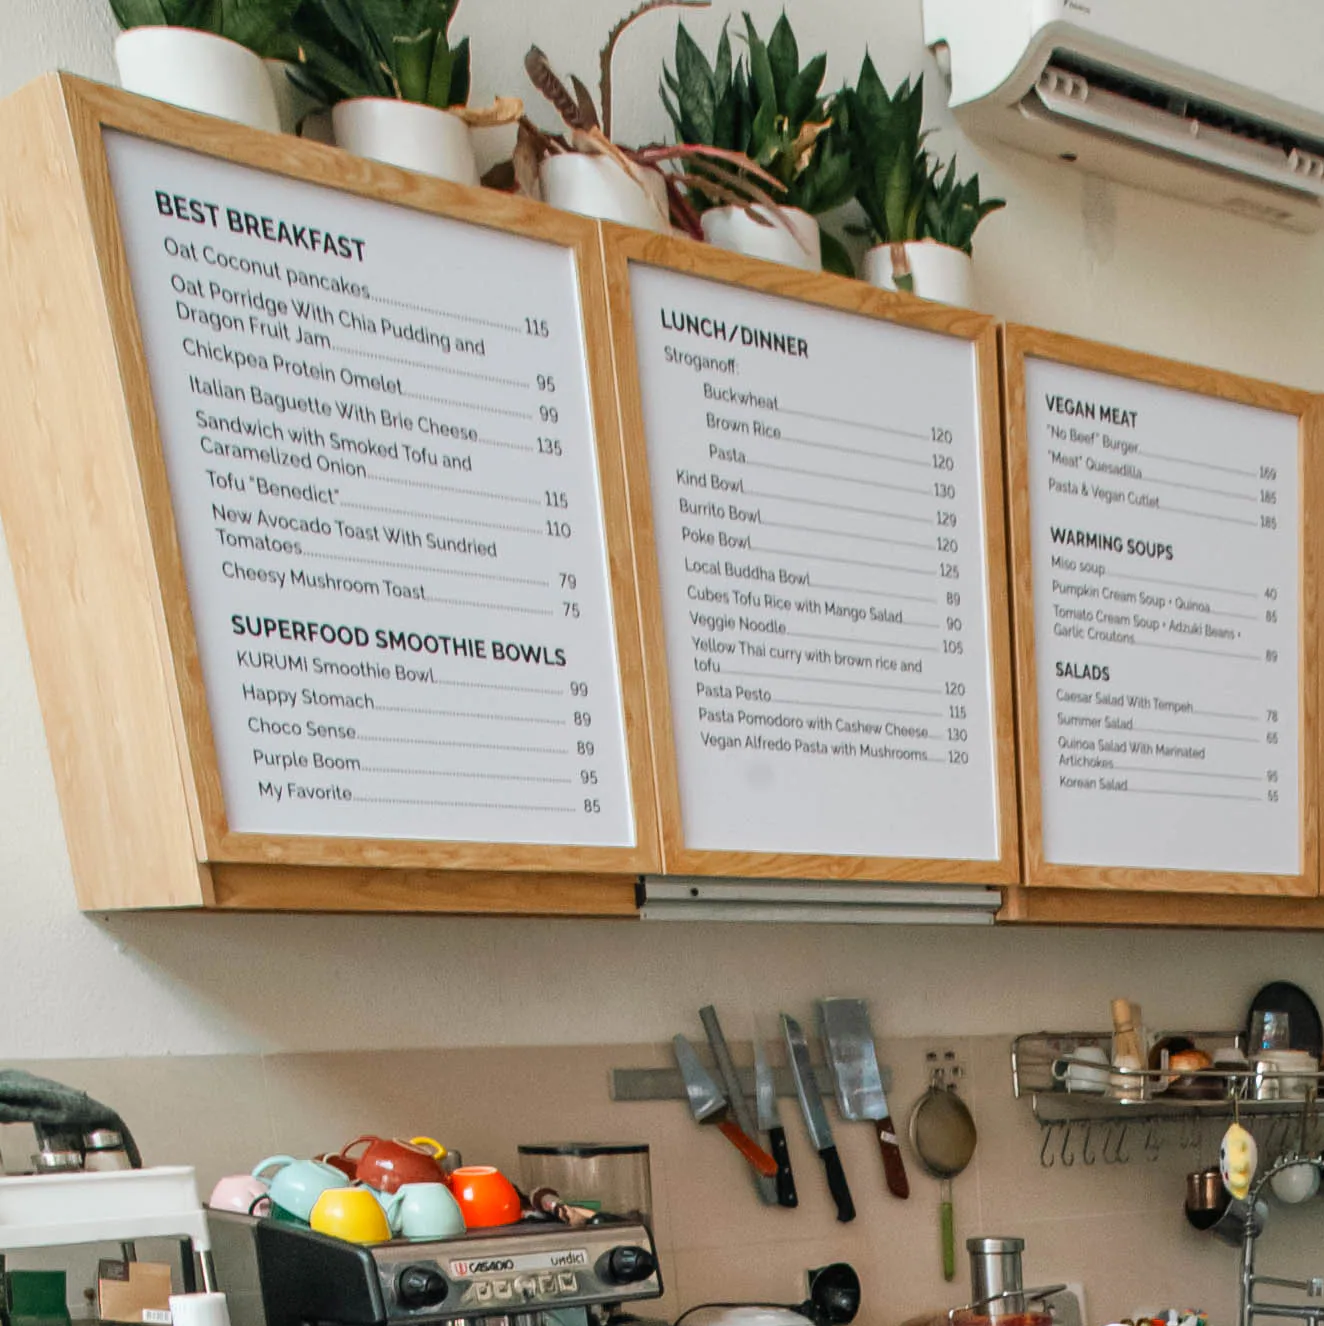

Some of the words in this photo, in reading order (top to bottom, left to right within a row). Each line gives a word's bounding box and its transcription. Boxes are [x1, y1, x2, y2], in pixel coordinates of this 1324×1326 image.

[155, 190, 219, 227] BEST
[226, 208, 365, 262] BREAKFAST
[164, 237, 198, 261] Oat
[202, 245, 281, 280] Coconut
[286, 268, 370, 299] pancakes
[525, 317, 549, 337] 115
[170, 274, 204, 298] Oat
[209, 281, 287, 317] Porridge
[291, 299, 334, 324] With
[338, 310, 376, 333] Chia
[381, 318, 450, 352] Pudding
[455, 339, 485, 355] and
[660, 308, 808, 358] LUNCH/DINNER
[175, 300, 244, 332] Dragon
[249, 315, 290, 341] Fruit
[295, 326, 330, 348] Jam
[536, 374, 555, 392] 95
[182, 337, 268, 369] Chickpea
[272, 354, 335, 382] Protein
[340, 368, 402, 395] Omelet
[539, 405, 558, 423] 99
[189, 375, 245, 400] Italian
[250, 385, 331, 416] Baguette
[335, 401, 376, 424] With
[380, 409, 413, 430] Brie
[417, 416, 477, 441] Cheese
[537, 437, 562, 456] 135
[703, 382, 779, 411] Buckwheat
[931, 426, 952, 444] 120
[1045, 394, 1095, 420] VEGAN
[1099, 405, 1137, 428] MEAT
[195, 410, 284, 440] Sandwich
[287, 427, 325, 447] with
[329, 432, 398, 459] Smoked
[402, 444, 437, 465] Tofu
[442, 455, 472, 471] and
[706, 412, 749, 433] Brown
[753, 420, 781, 439] Rice
[932, 453, 954, 471] 120
[200, 436, 312, 469] Caramelized
[316, 454, 366, 478] Onion
[545, 490, 568, 508] 115
[709, 443, 745, 463] Pasta
[934, 482, 955, 499] 130
[205, 469, 245, 491] Tofu
[546, 519, 571, 538] 110
[676, 469, 707, 488] Kind
[710, 473, 744, 493] Bowl
[937, 510, 956, 527] 129
[212, 503, 251, 524] New
[257, 509, 331, 535] Avocado
[334, 520, 379, 541] Toast
[382, 527, 422, 547] With
[426, 533, 497, 557] Sundried
[679, 497, 725, 518] Burrito
[728, 504, 761, 524] Bowl
[937, 536, 958, 553] 120
[1050, 526, 1123, 552] WARMING
[1127, 538, 1173, 560] SOUPS
[215, 528, 302, 554] Tomatoes
[559, 572, 576, 589] 79
[681, 526, 714, 544] Poke
[718, 531, 751, 549] Bowl
[940, 562, 959, 579] 125
[1051, 554, 1076, 570] Miso
[1079, 562, 1105, 577] soup
[222, 561, 285, 588] Cheesy
[290, 568, 379, 594] Mushroom
[382, 579, 425, 600] Toast
[563, 601, 580, 618] 75
[684, 556, 721, 576] Local
[724, 561, 775, 582] Buddha
[778, 568, 810, 586] Bowl
[946, 591, 960, 606] 89
[687, 584, 729, 604] Cubes
[732, 589, 760, 607] Tofu
[763, 593, 791, 610] Rice
[794, 599, 821, 614] with
[824, 601, 866, 622] Mango
[869, 606, 903, 624] Salad
[946, 616, 962, 631] 90
[689, 611, 735, 631] Veggie
[739, 616, 786, 634] Noodle
[942, 639, 963, 655] 105
[231, 614, 369, 646] SUPERFOOD
[375, 629, 486, 658] SMOOTHIE
[491, 641, 566, 666] BOWLS
[692, 636, 736, 654] Yellow
[738, 640, 765, 656] Thai
[769, 647, 801, 664] curry
[804, 649, 831, 664] with
[834, 649, 872, 668] brown
[875, 656, 897, 670] rice
[900, 659, 922, 672] and
[237, 650, 307, 672] KURUMI
[312, 657, 390, 678] Smoothie
[395, 664, 434, 683] Bowl
[570, 681, 588, 696] 99
[694, 657, 720, 672] tofu
[945, 681, 965, 696] 120
[1055, 661, 1109, 681] SALADS
[242, 683, 296, 707] Happy
[301, 688, 374, 709] Stomach
[573, 711, 591, 727] 89
[696, 681, 732, 698] Pasta
[735, 685, 771, 702] Pesto
[949, 704, 966, 719] 115
[698, 706, 734, 723] Pasta
[737, 709, 803, 728] Pomodoro
[806, 716, 832, 730] with
[835, 718, 882, 734] Cashew
[884, 722, 928, 738] Cheese
[947, 727, 967, 742] 130
[247, 717, 301, 735] Choco
[306, 720, 355, 738] Sense
[576, 740, 594, 755] 89
[700, 731, 741, 750] Vegan
[744, 735, 791, 751] Alfredo
[794, 738, 828, 754] Pasta
[830, 743, 856, 756] with
[859, 743, 927, 760] Mushrooms
[948, 750, 968, 764] 120
[253, 748, 308, 770] Purple
[312, 752, 360, 770] Boom
[580, 769, 597, 784] 95
[258, 781, 282, 801] My
[287, 782, 352, 800] Favorite
[583, 798, 600, 813] 85
[469, 1259, 514, 1273] CASADIO
